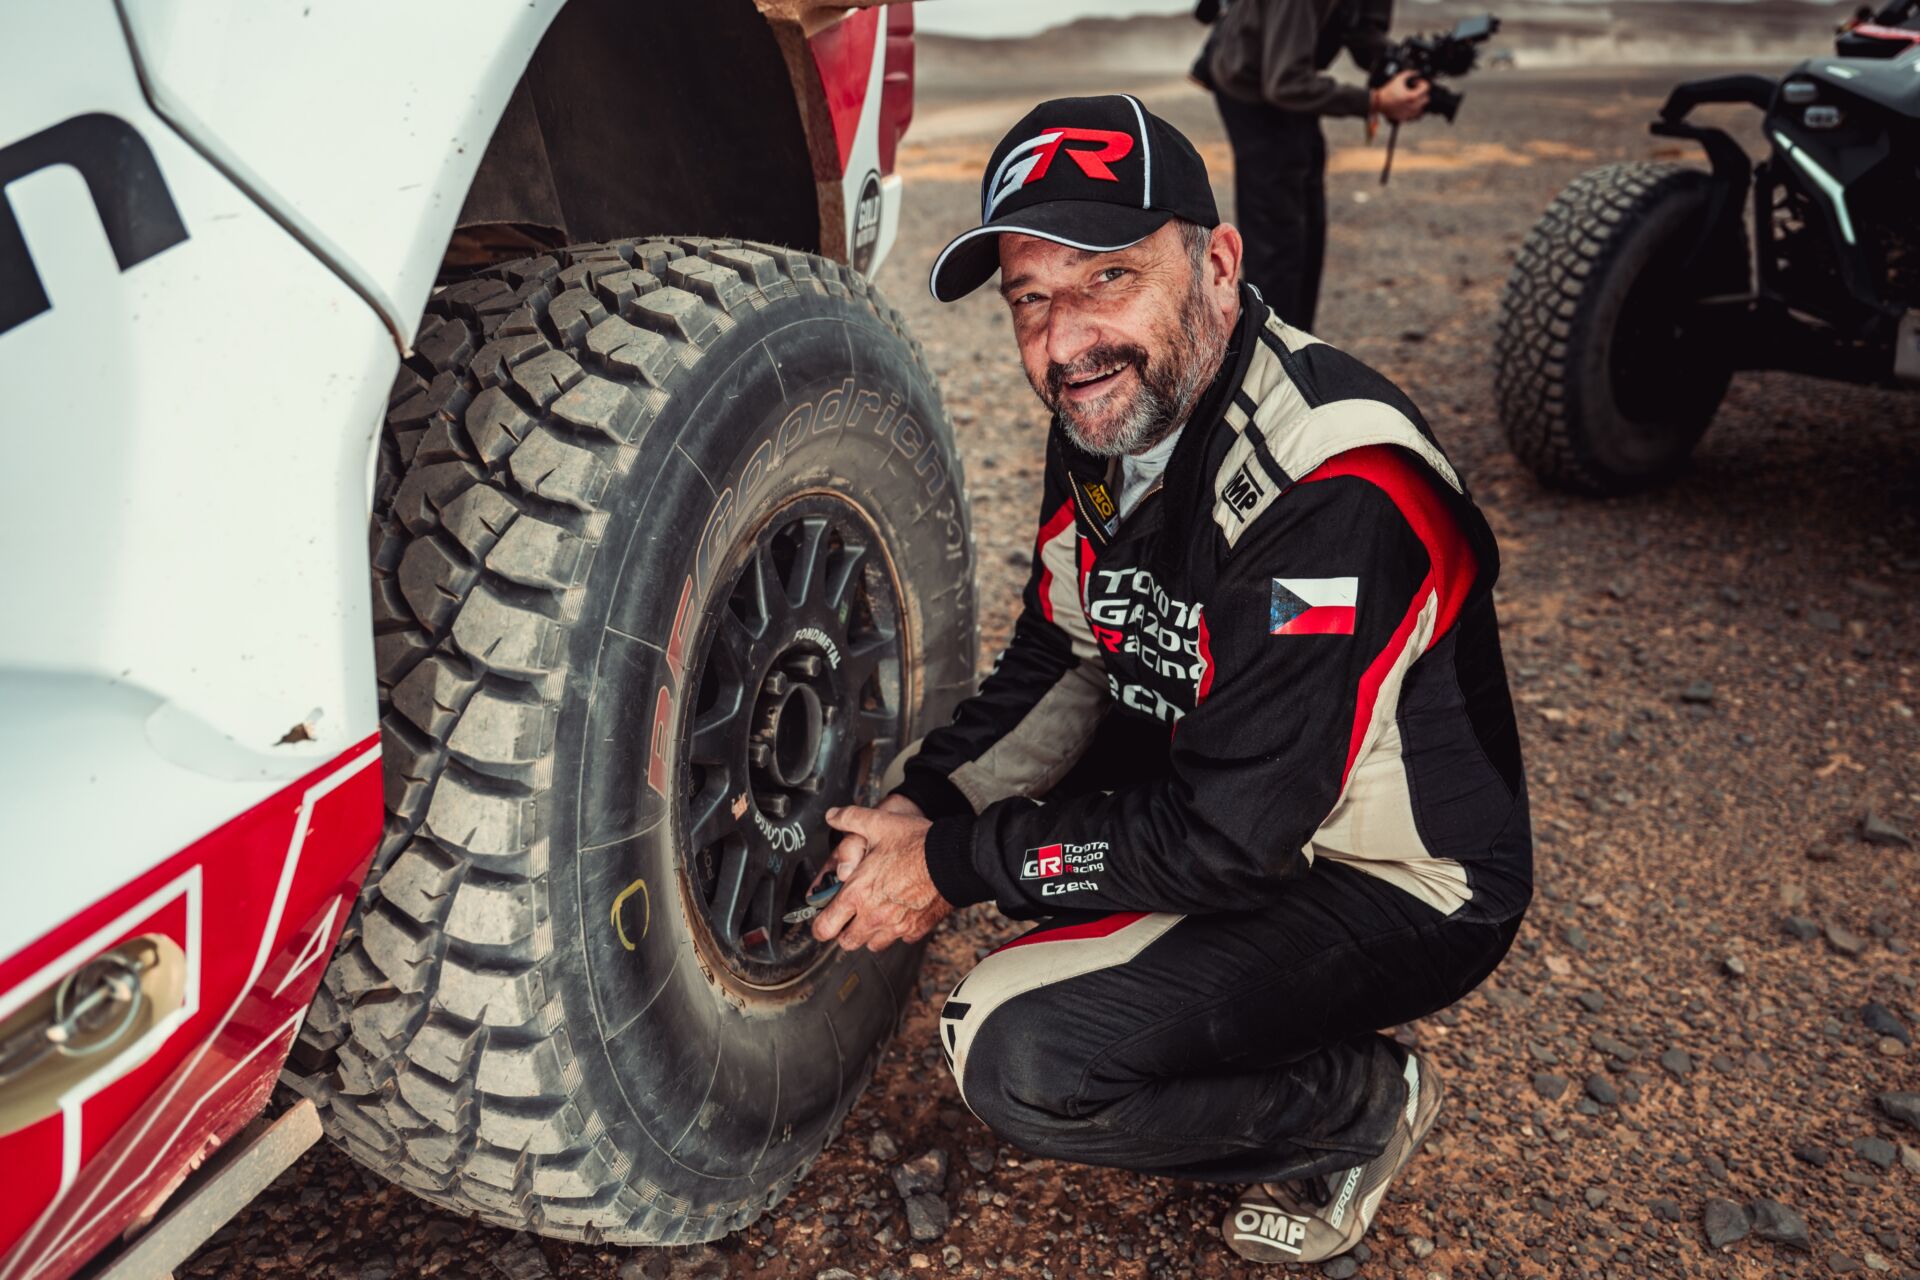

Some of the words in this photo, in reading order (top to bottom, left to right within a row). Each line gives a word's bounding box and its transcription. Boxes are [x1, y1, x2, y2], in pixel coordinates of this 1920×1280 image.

[1223, 473, 1258, 511] MP
[793, 627, 841, 670] FONDMETAL
[1024, 856, 1061, 877] GR
[1042, 880, 1099, 896] Czech
[1234, 1209, 1306, 1246] OMP
